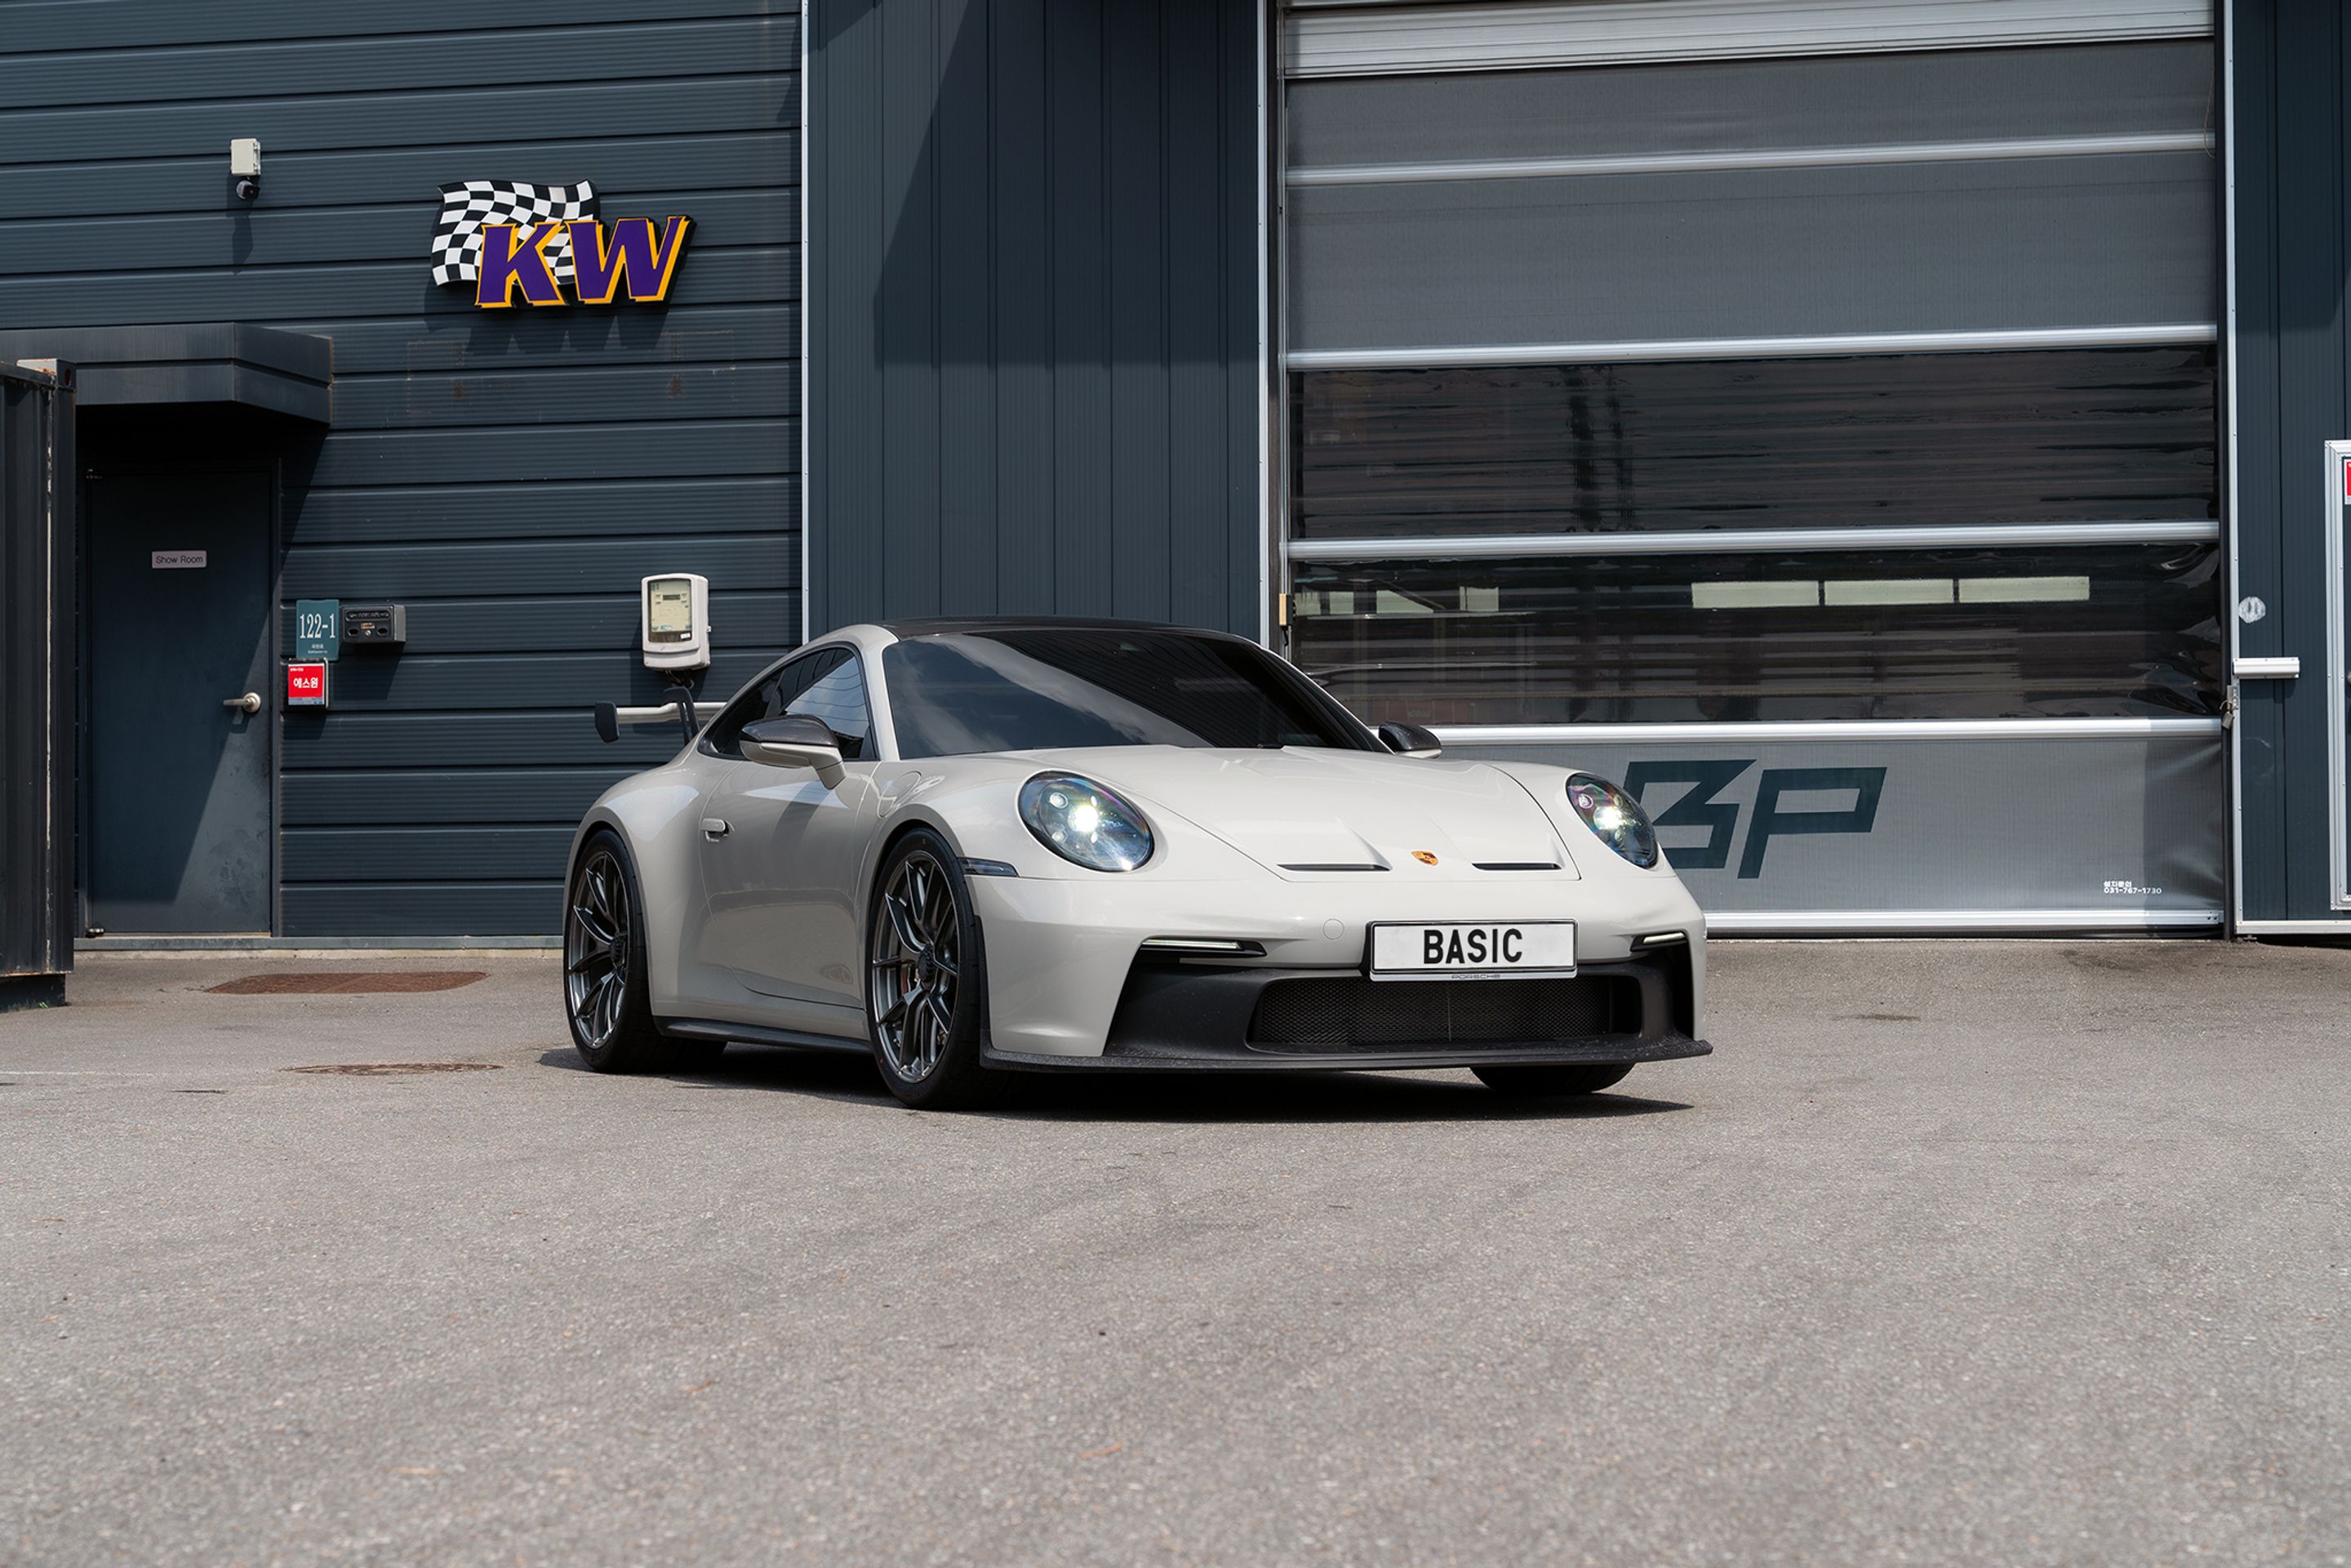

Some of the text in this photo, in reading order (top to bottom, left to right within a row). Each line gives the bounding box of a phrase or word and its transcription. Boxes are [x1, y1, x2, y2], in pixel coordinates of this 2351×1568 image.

[474, 215, 692, 309] KW
[156, 554, 203, 564] Show Room
[299, 613, 336, 639] 122-1
[293, 677, 319, 689] 에스원
[1423, 928, 1523, 964] BASIC
